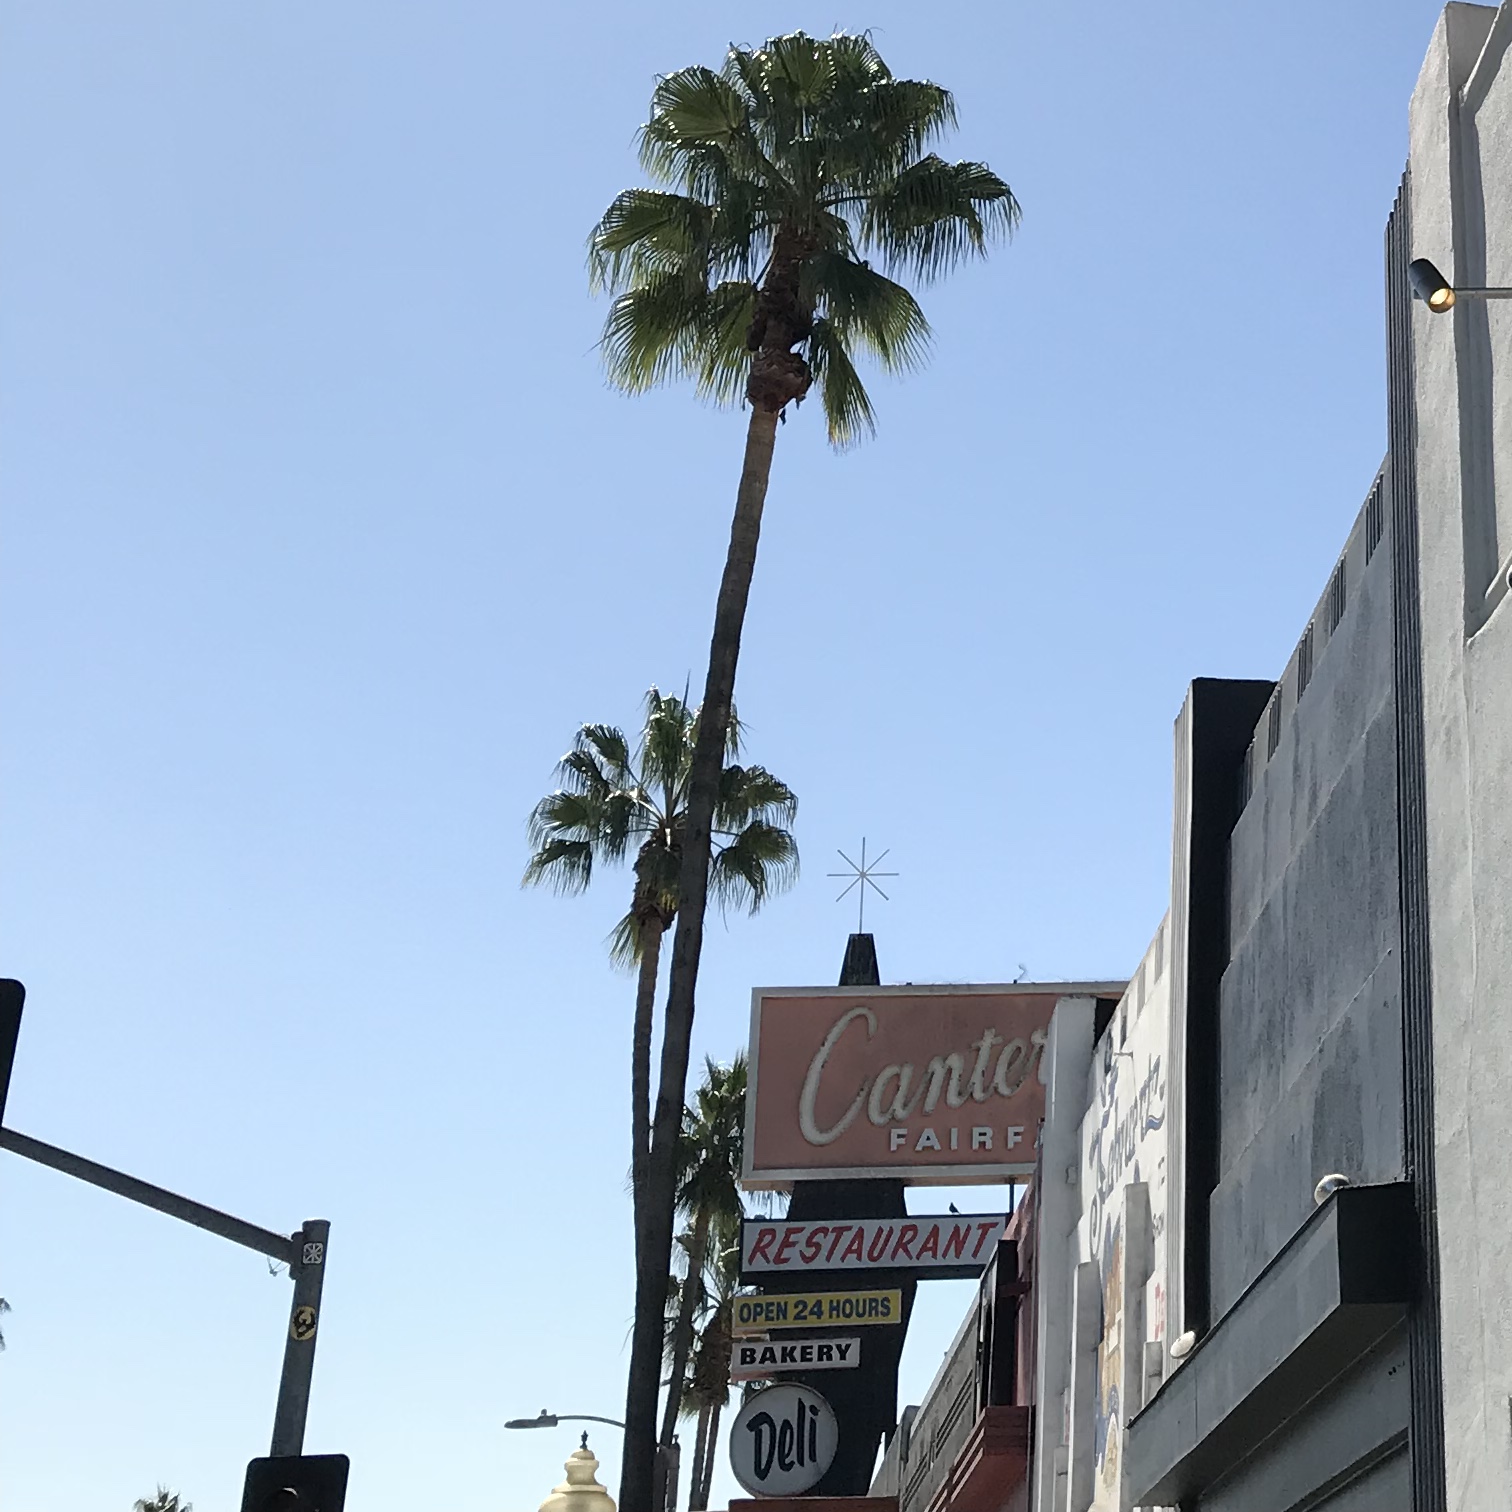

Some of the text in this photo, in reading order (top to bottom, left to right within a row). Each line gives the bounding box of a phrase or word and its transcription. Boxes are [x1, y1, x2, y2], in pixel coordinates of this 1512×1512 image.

[890, 1125, 1042, 1152] FAIRF
[748, 1222, 998, 1264] RESTAURANT
[739, 1295, 891, 1324] OPEN 24 HOURS
[740, 1344, 852, 1366] BAKERY
[747, 1398, 820, 1482] Deli
